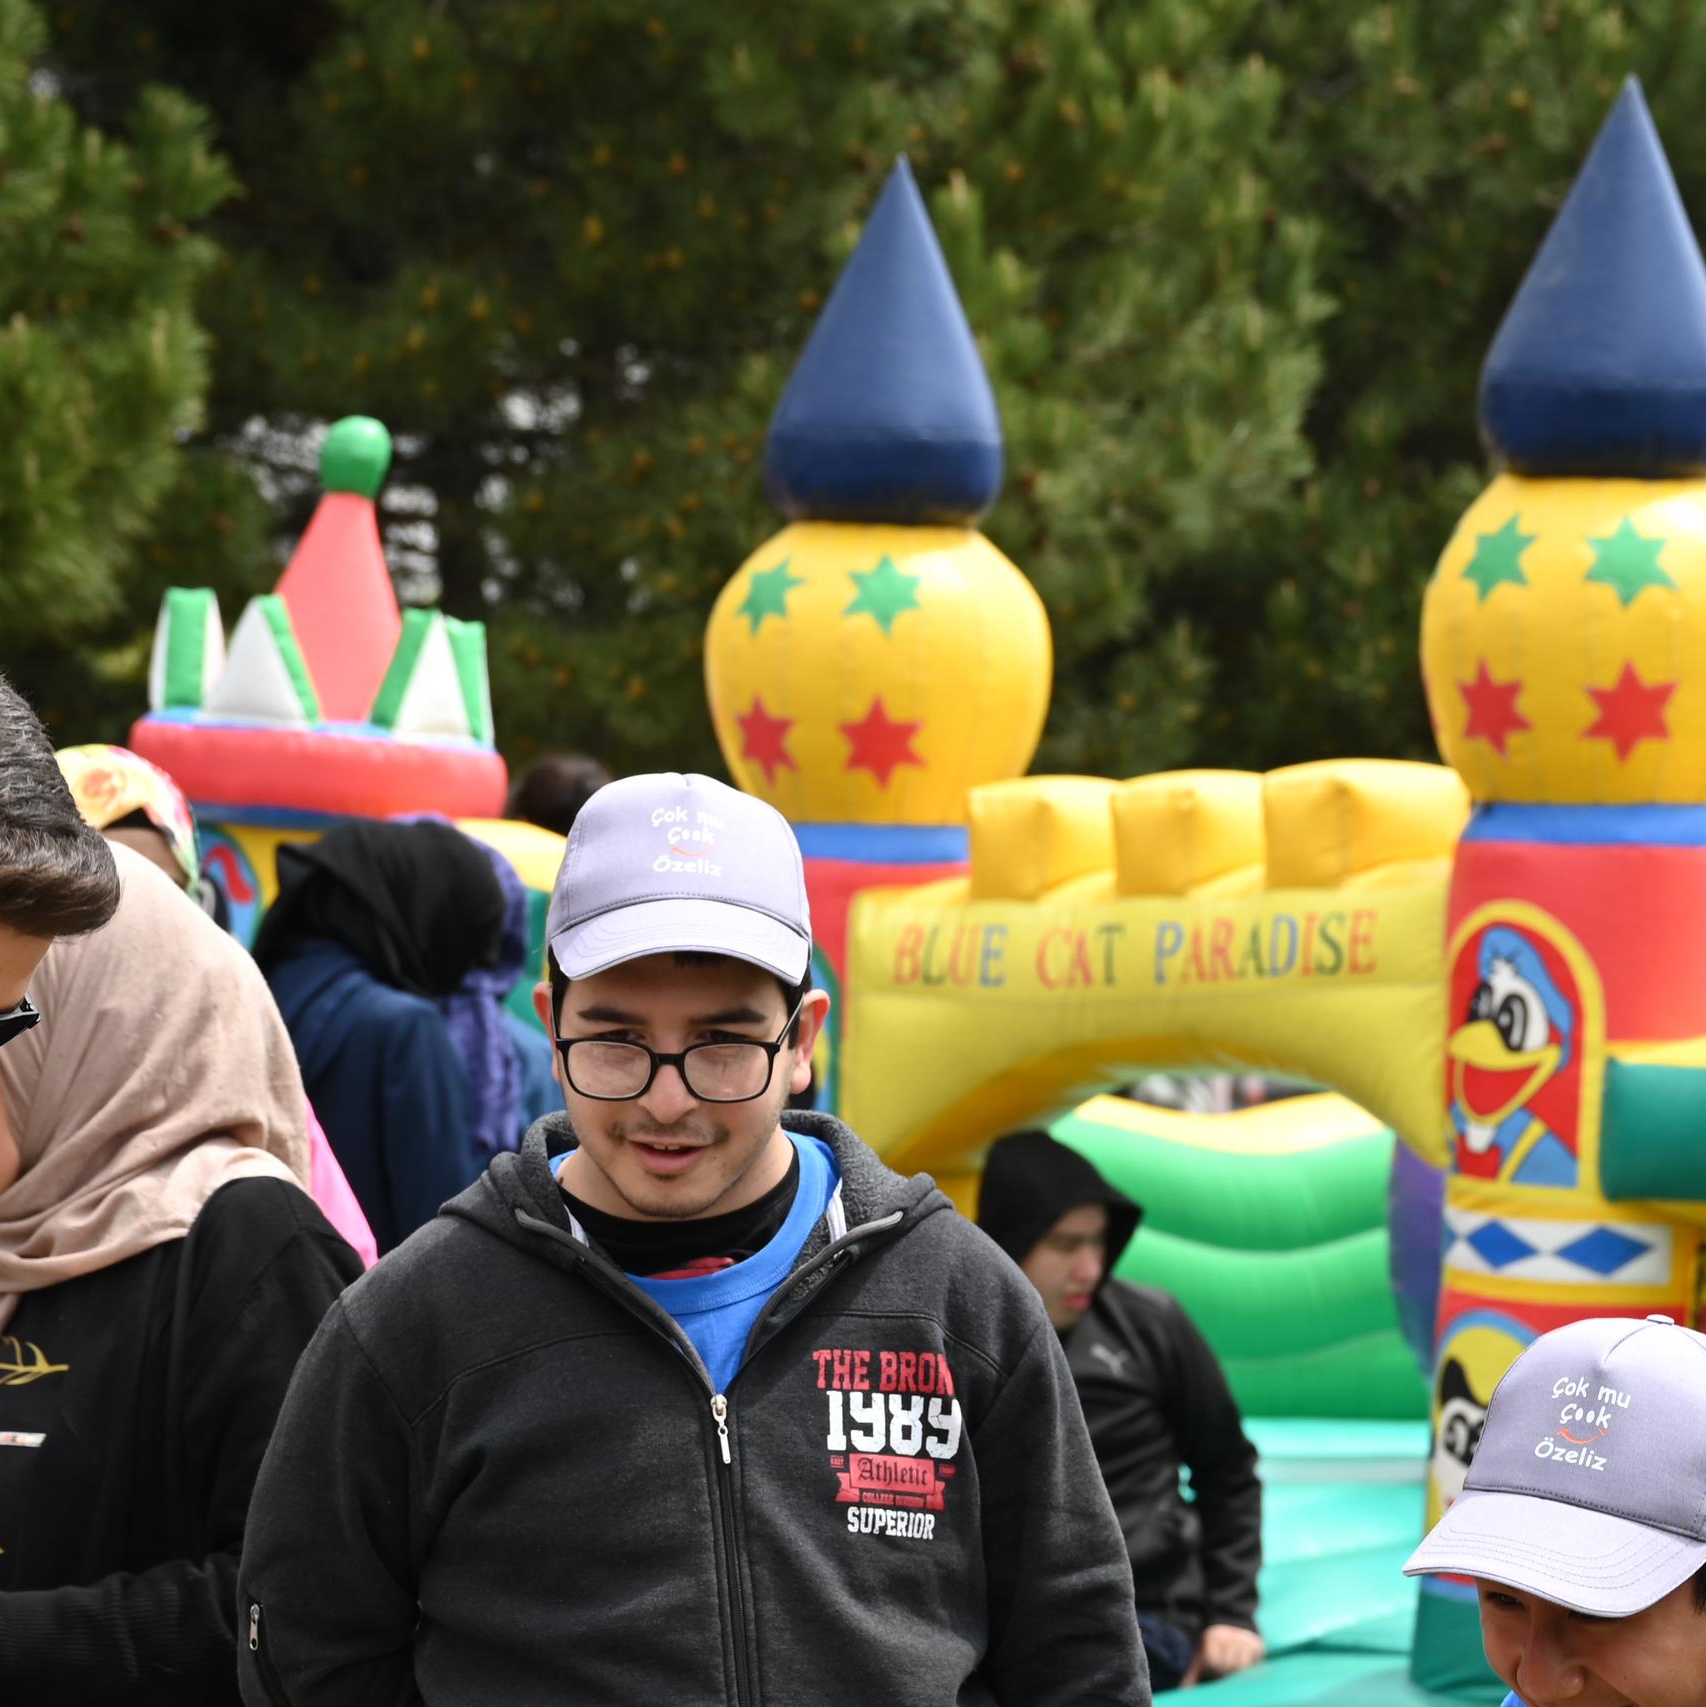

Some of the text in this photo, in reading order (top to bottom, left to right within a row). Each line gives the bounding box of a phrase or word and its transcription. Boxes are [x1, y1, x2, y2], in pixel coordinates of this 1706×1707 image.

[651, 805, 725, 830] Çok mu
[652, 854, 723, 877] Özeliz
[893, 909, 1378, 990] BLUE CAT PARADISE
[812, 1350, 870, 1390] THE
[1551, 1376, 1631, 1409] Çok mu
[826, 1390, 962, 1460] 1989
[1534, 1436, 1607, 1471] Özeliz
[857, 1457, 928, 1487] Athletic
[847, 1506, 935, 1540] SUPERIOR
